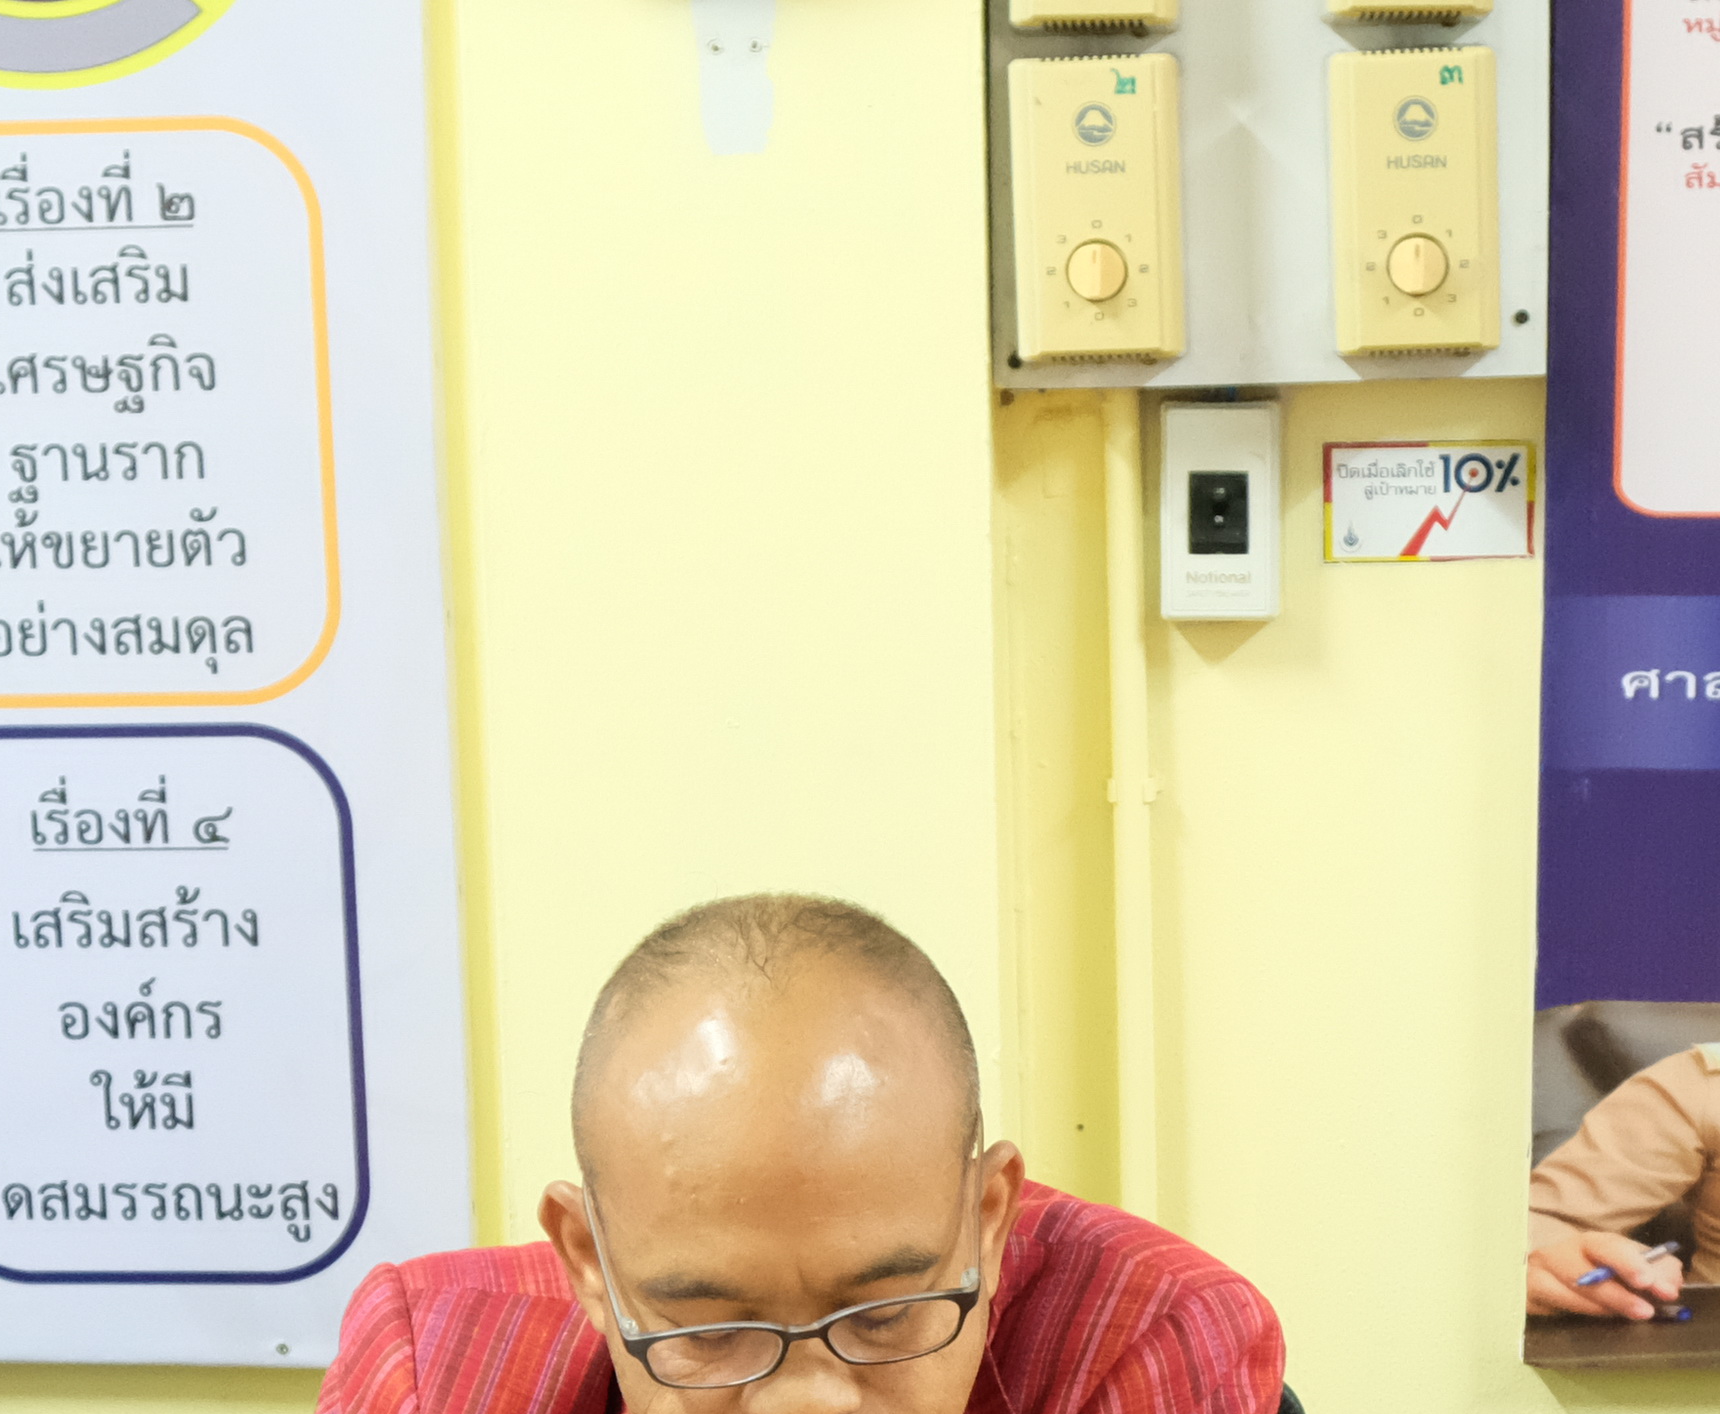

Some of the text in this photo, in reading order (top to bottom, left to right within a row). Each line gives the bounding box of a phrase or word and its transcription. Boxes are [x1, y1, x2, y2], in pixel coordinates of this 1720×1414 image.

[1387, 155, 1447, 169] HUSAN
[158, 181, 196, 223] ๒
[5, 245, 188, 306] ส่งเสริม
[9, 441, 204, 504] ฐานราก
[1439, 452, 1521, 493] 10%
[29, 775, 234, 847] เรื่องที่ ๔
[13, 886, 259, 948] เสริมสร้าง
[59, 978, 221, 1040] องค์กร
[91, 1070, 194, 1130] ให้มี
